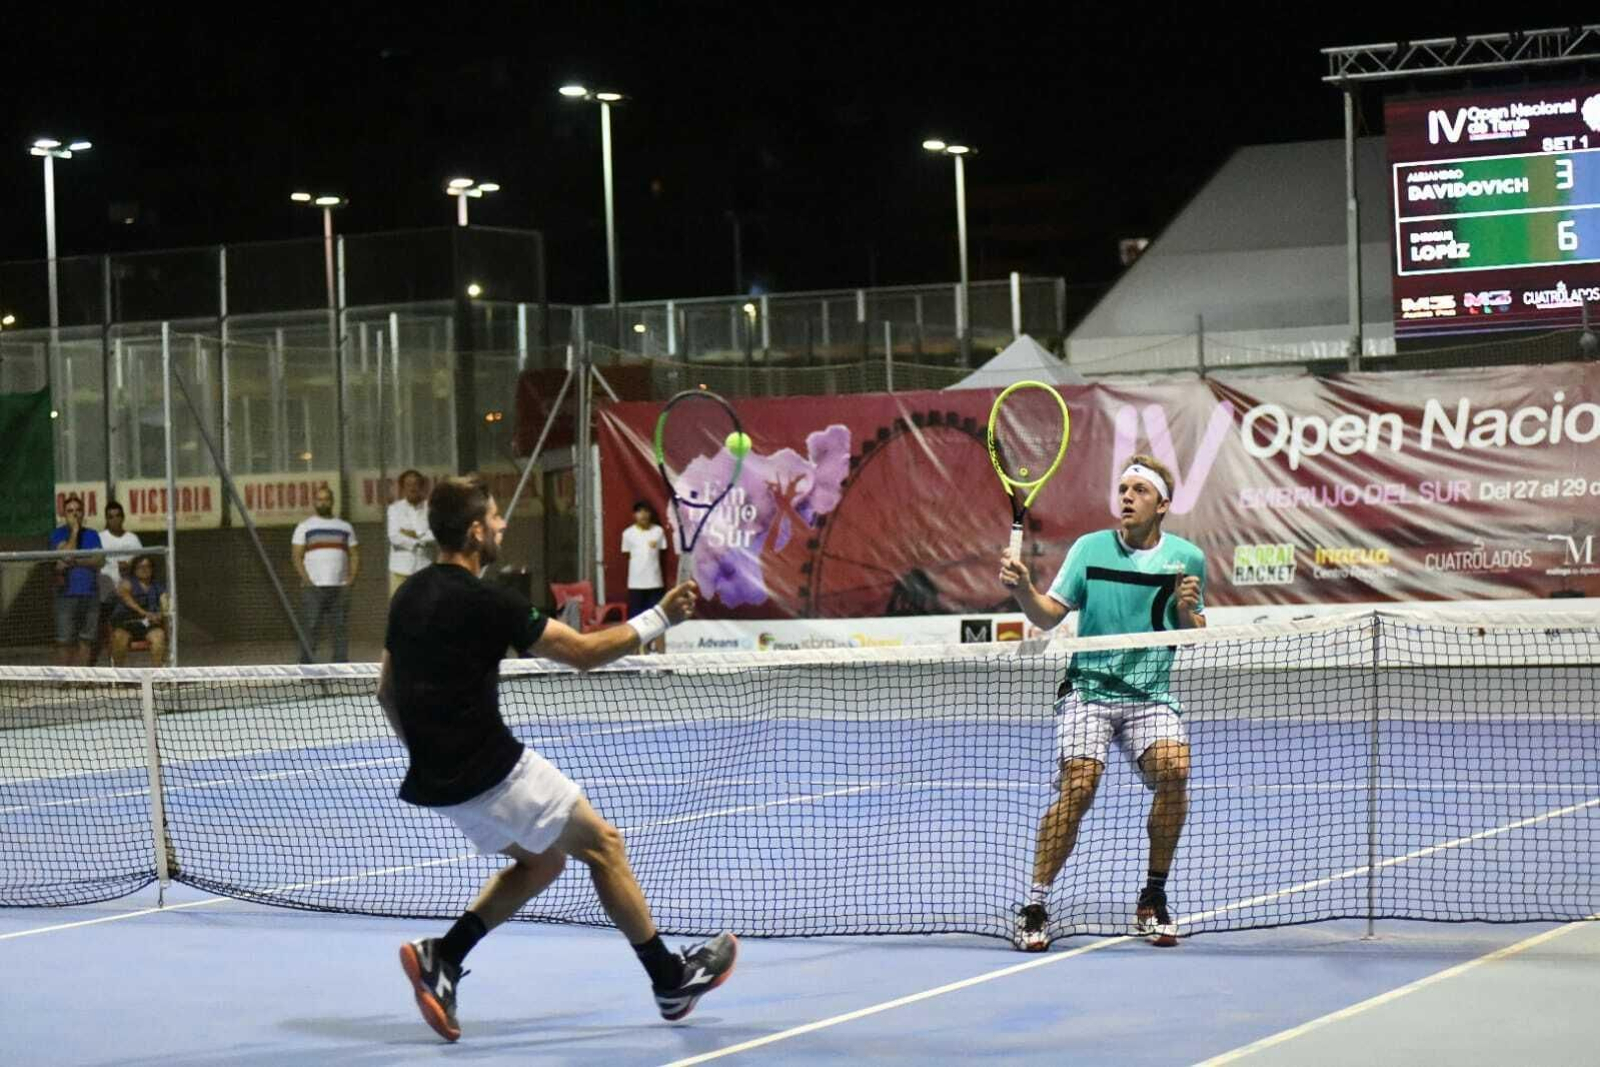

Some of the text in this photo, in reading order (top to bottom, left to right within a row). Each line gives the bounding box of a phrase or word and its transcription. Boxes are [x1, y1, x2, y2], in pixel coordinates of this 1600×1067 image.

[1428, 108, 1467, 144] IV
[1542, 136, 1576, 151] SET
[1579, 134, 1589, 149] 1
[1555, 159, 1574, 189] 3
[1407, 177, 1529, 201] DAVIDOVICH
[1557, 220, 1578, 250] 6
[1241, 403, 1402, 471] Open
[1365, 482, 1414, 505] DEL
[1419, 480, 1471, 503] SUR
[1479, 481, 1511, 501] Del
[1514, 480, 1539, 499] 27
[1541, 479, 1559, 498] al
[1562, 478, 1587, 497] 29
[1425, 550, 1533, 571] CUATROLADOS
[1235, 564, 1297, 582] RACKET
